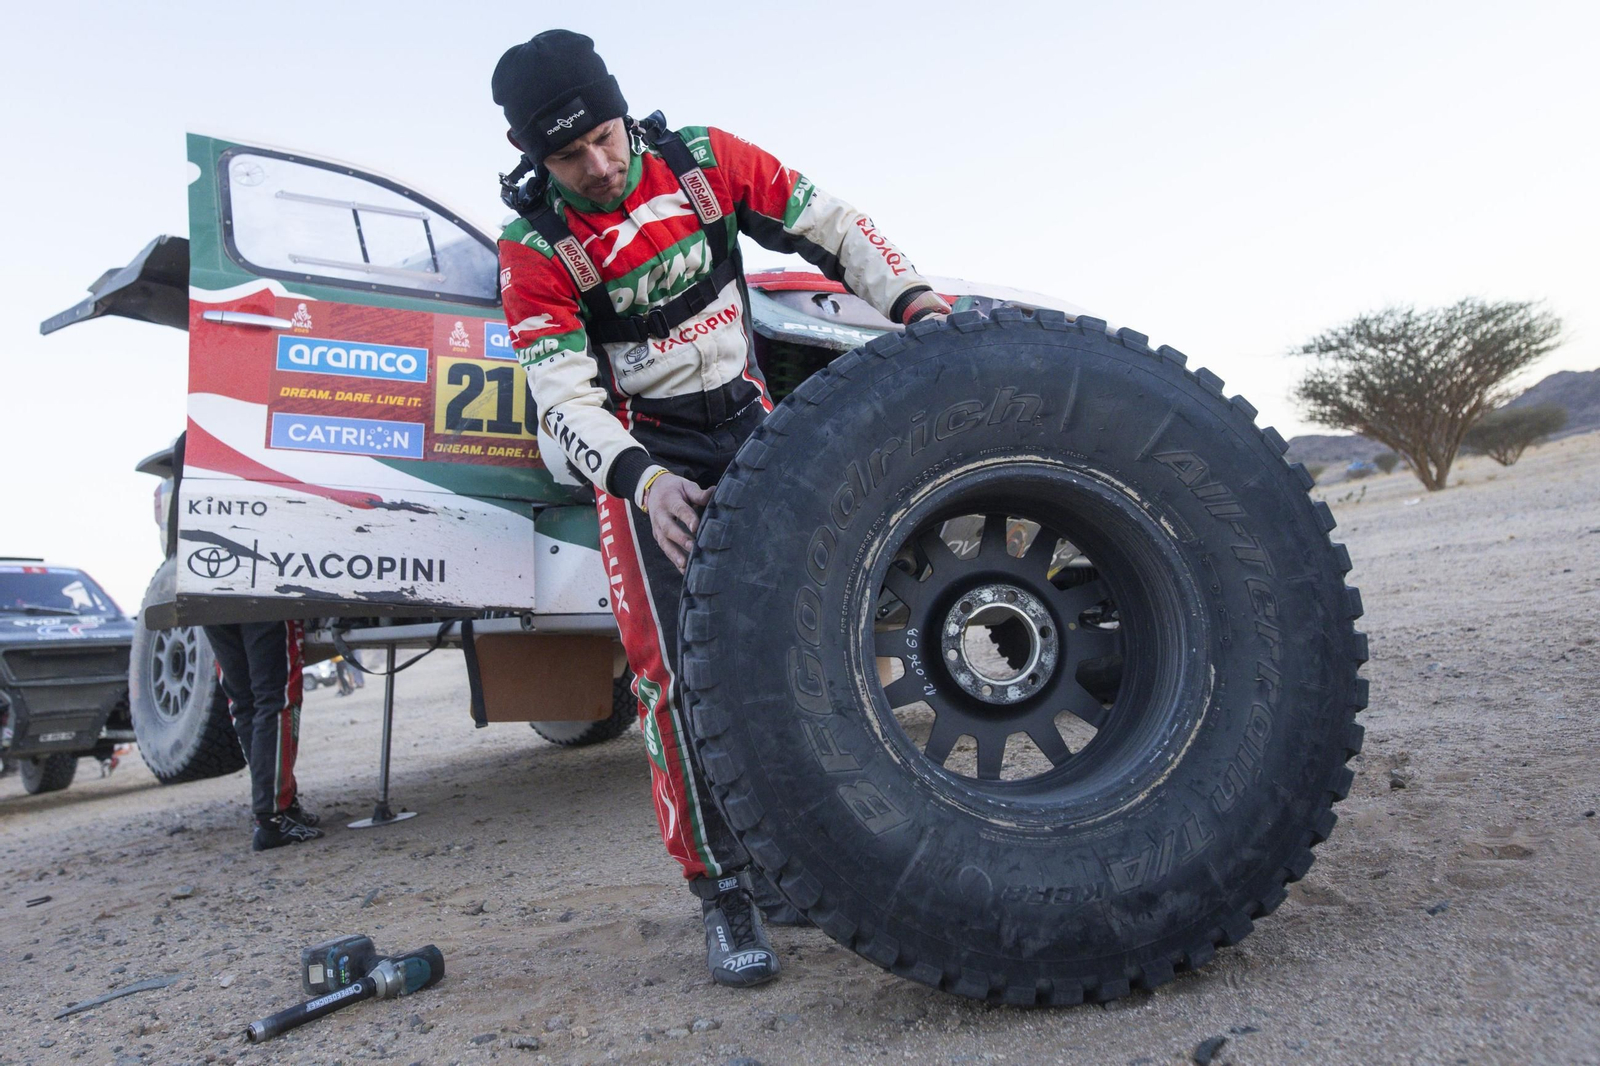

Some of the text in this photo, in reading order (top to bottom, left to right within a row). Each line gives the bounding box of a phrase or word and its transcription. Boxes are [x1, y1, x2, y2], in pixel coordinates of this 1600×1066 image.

[687, 175, 717, 217] SIMPSON
[856, 217, 907, 276] TOYOTA
[562, 243, 594, 284] SIMPSON
[288, 343, 418, 375] aramco
[279, 386, 422, 407] DREAM. DARE. LIVE IT.
[433, 442, 484, 456] DREAM.
[487, 446, 526, 458] DARE.
[269, 551, 446, 582] YACOPINI
[718, 878, 738, 890] OMP
[715, 925, 730, 952] one
[722, 953, 768, 971] OMP
